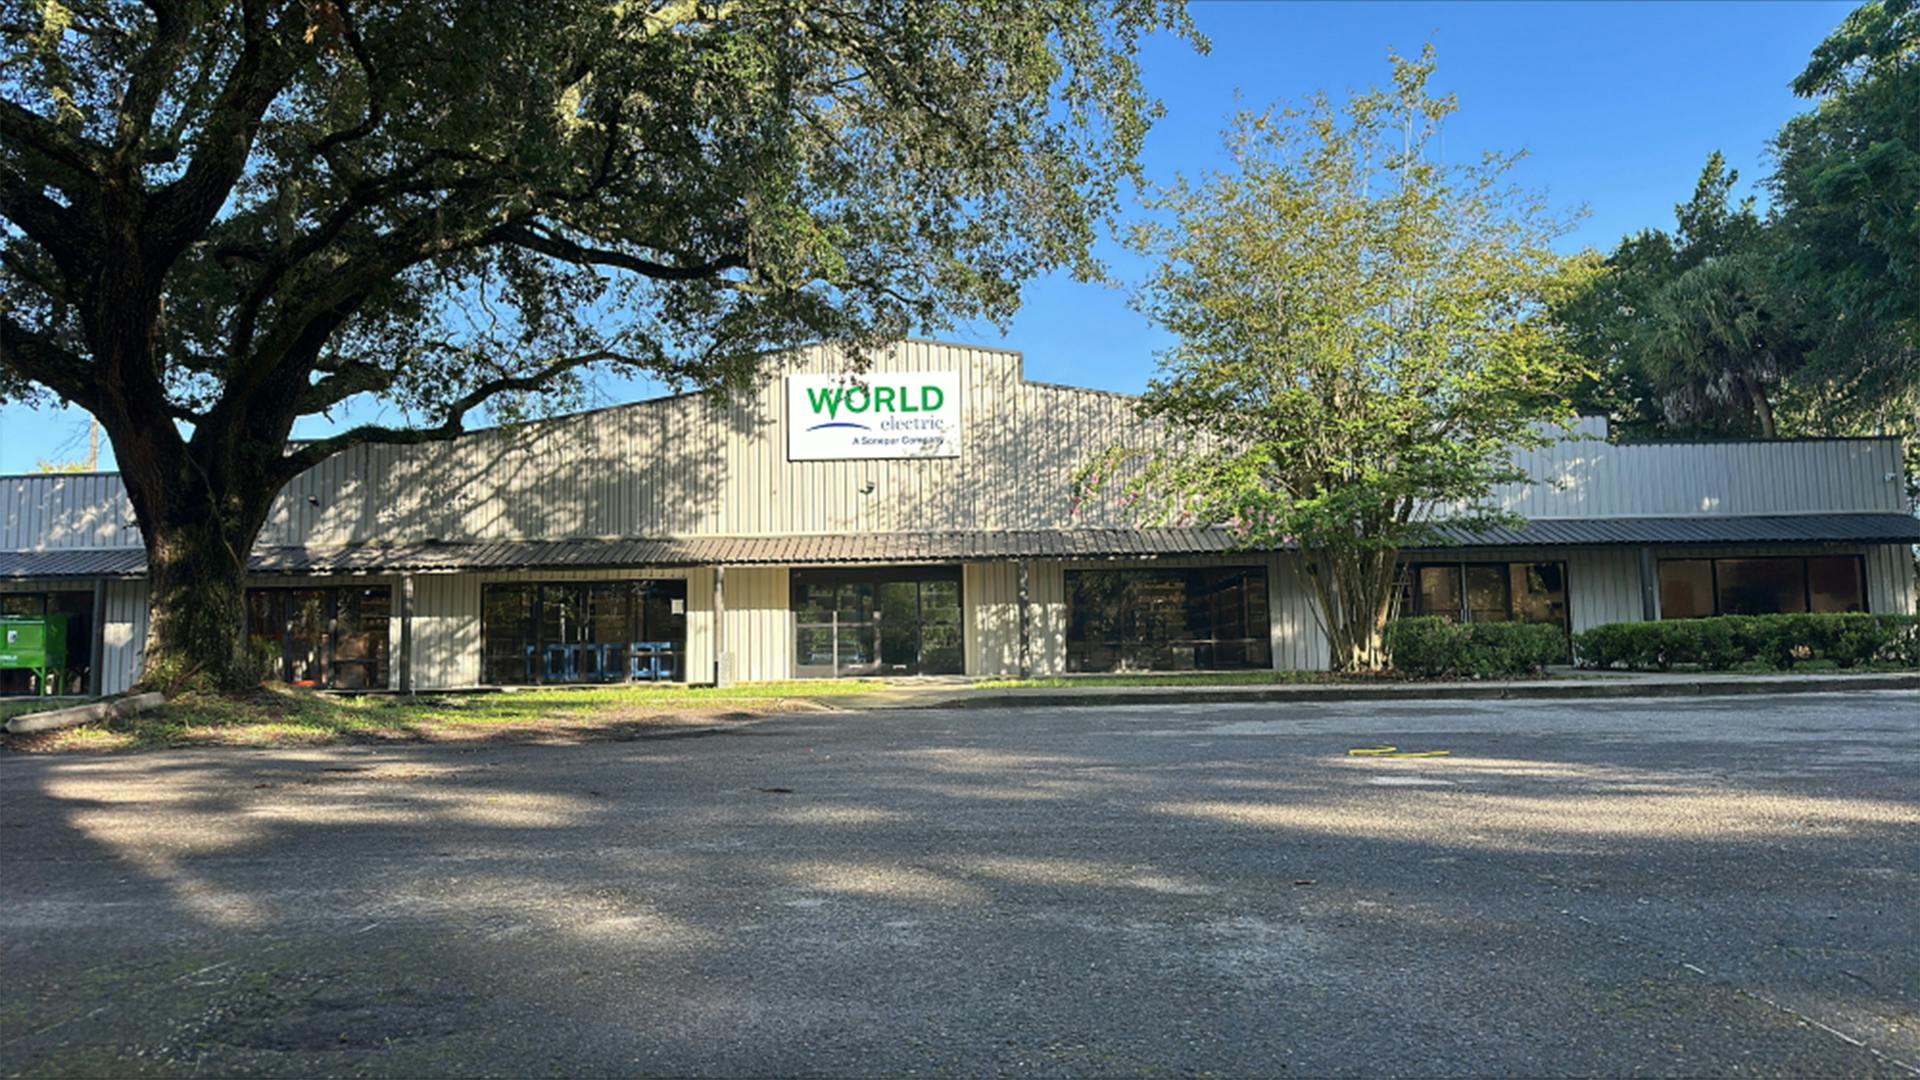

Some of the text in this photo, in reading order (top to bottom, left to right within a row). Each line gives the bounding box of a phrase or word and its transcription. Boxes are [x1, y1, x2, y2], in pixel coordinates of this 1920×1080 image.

[807, 386, 944, 420] WORLD
[880, 415, 944, 431] electric
[852, 437, 860, 445] A
